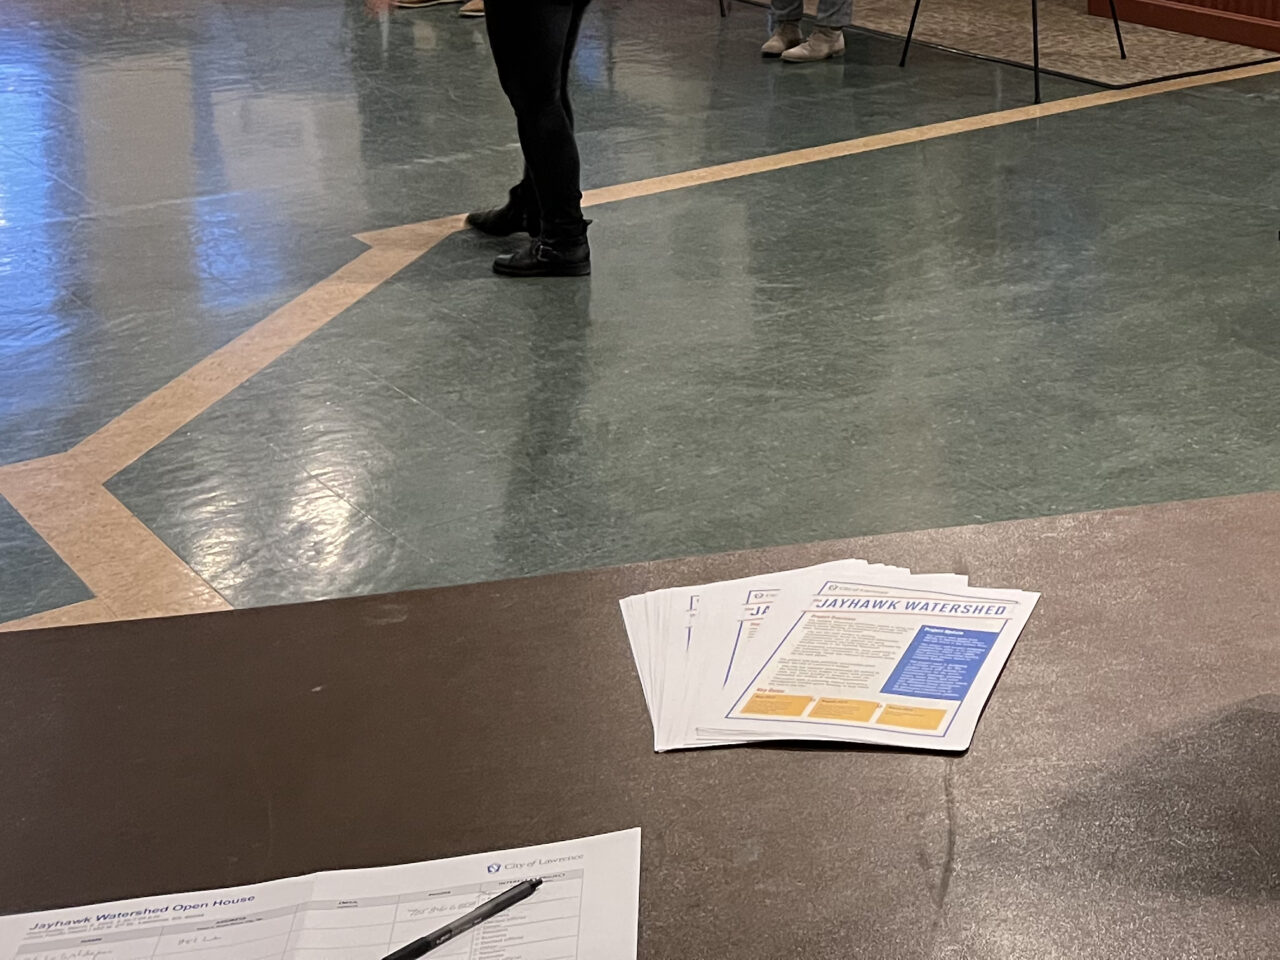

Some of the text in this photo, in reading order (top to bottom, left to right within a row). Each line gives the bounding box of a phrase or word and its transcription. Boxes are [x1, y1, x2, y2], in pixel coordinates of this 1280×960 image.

[816, 598, 1006, 615] JAYHAWK WATERSHED
[538, 854, 584, 865] Lawrence
[29, 916, 91, 930] Jayhawk
[95, 906, 169, 921] Watershed
[172, 901, 209, 912] Open
[212, 895, 255, 907] House
